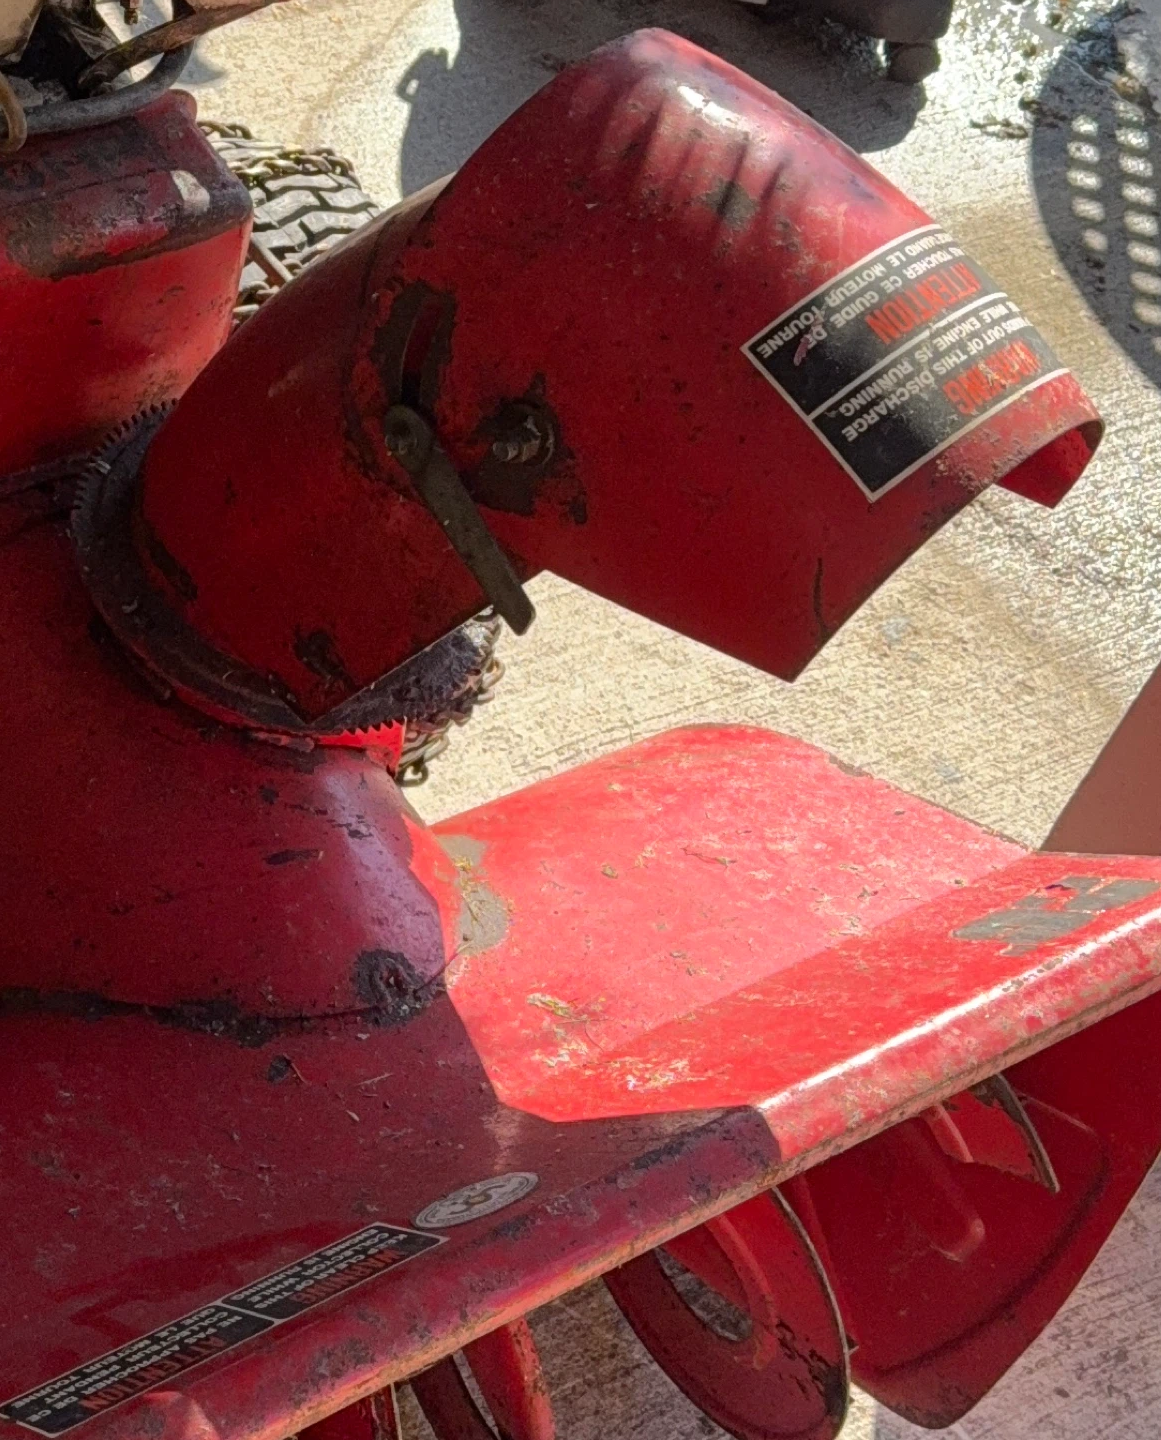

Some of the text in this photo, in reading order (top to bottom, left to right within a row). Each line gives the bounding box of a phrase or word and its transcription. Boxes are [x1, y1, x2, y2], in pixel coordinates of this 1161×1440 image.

[886, 251, 906, 267] LE
[902, 251, 951, 279] TOUCHER
[825, 262, 886, 308] MOTEUR
[880, 276, 901, 292] CE
[829, 291, 879, 328] GUIDE
[865, 263, 980, 345] ATTENTION
[756, 306, 823, 358] TOURNE
[932, 317, 979, 351] ENGINE
[966, 338, 983, 355] OF
[981, 323, 1005, 343] OUT
[915, 343, 932, 362] IS
[933, 348, 968, 374] THIS
[839, 358, 913, 416] RUNNING
[842, 370, 935, 442] DISCHARGE
[243, 1231, 393, 1303] COLLECTOR WHILE
[285, 1247, 410, 1304] WARNING
[300, 1256, 323, 1265] IS
[311, 1253, 369, 1280] CLEAR
[251, 1289, 295, 1309] THIS
[288, 1278, 318, 1291] OF
[8, 1307, 219, 1408] QUE LE MOTEUR TOURNE
[22, 1314, 244, 1423] NE PAS APPROCHER DE CE
[38, 1310, 232, 1404] COLLECTEUR PENDANT
[75, 1335, 232, 1410] ATTENTION
